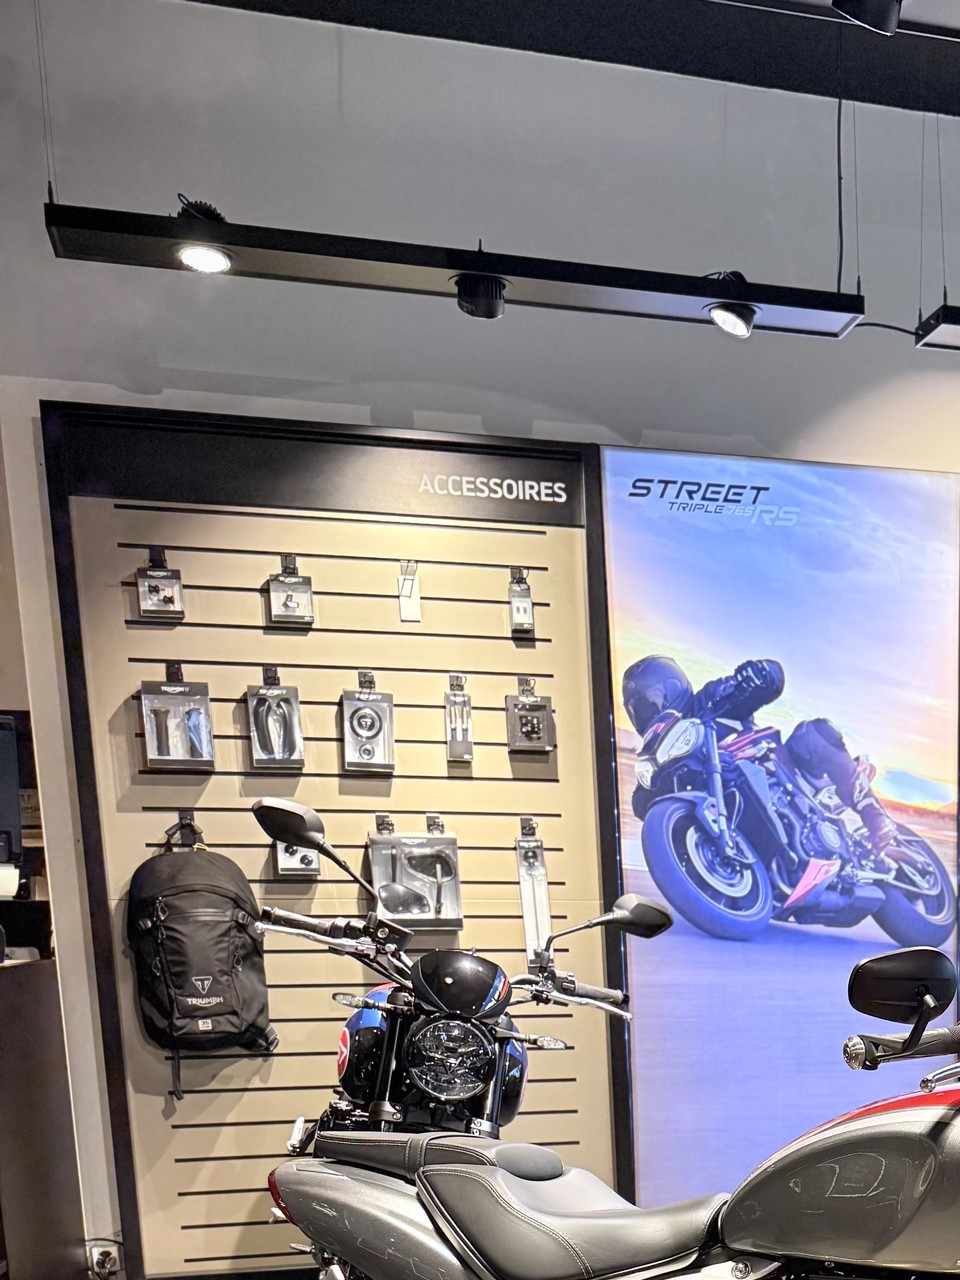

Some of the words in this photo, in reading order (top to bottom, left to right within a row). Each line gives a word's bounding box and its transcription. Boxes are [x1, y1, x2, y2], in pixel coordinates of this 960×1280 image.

[418, 473, 567, 503] ACCESSOIRES
[628, 478, 771, 505] STREET
[668, 501, 725, 514] TRIPLE
[726, 505, 755, 516] 765
[751, 504, 802, 526] RS
[187, 996, 224, 1007] TRIUMPH
